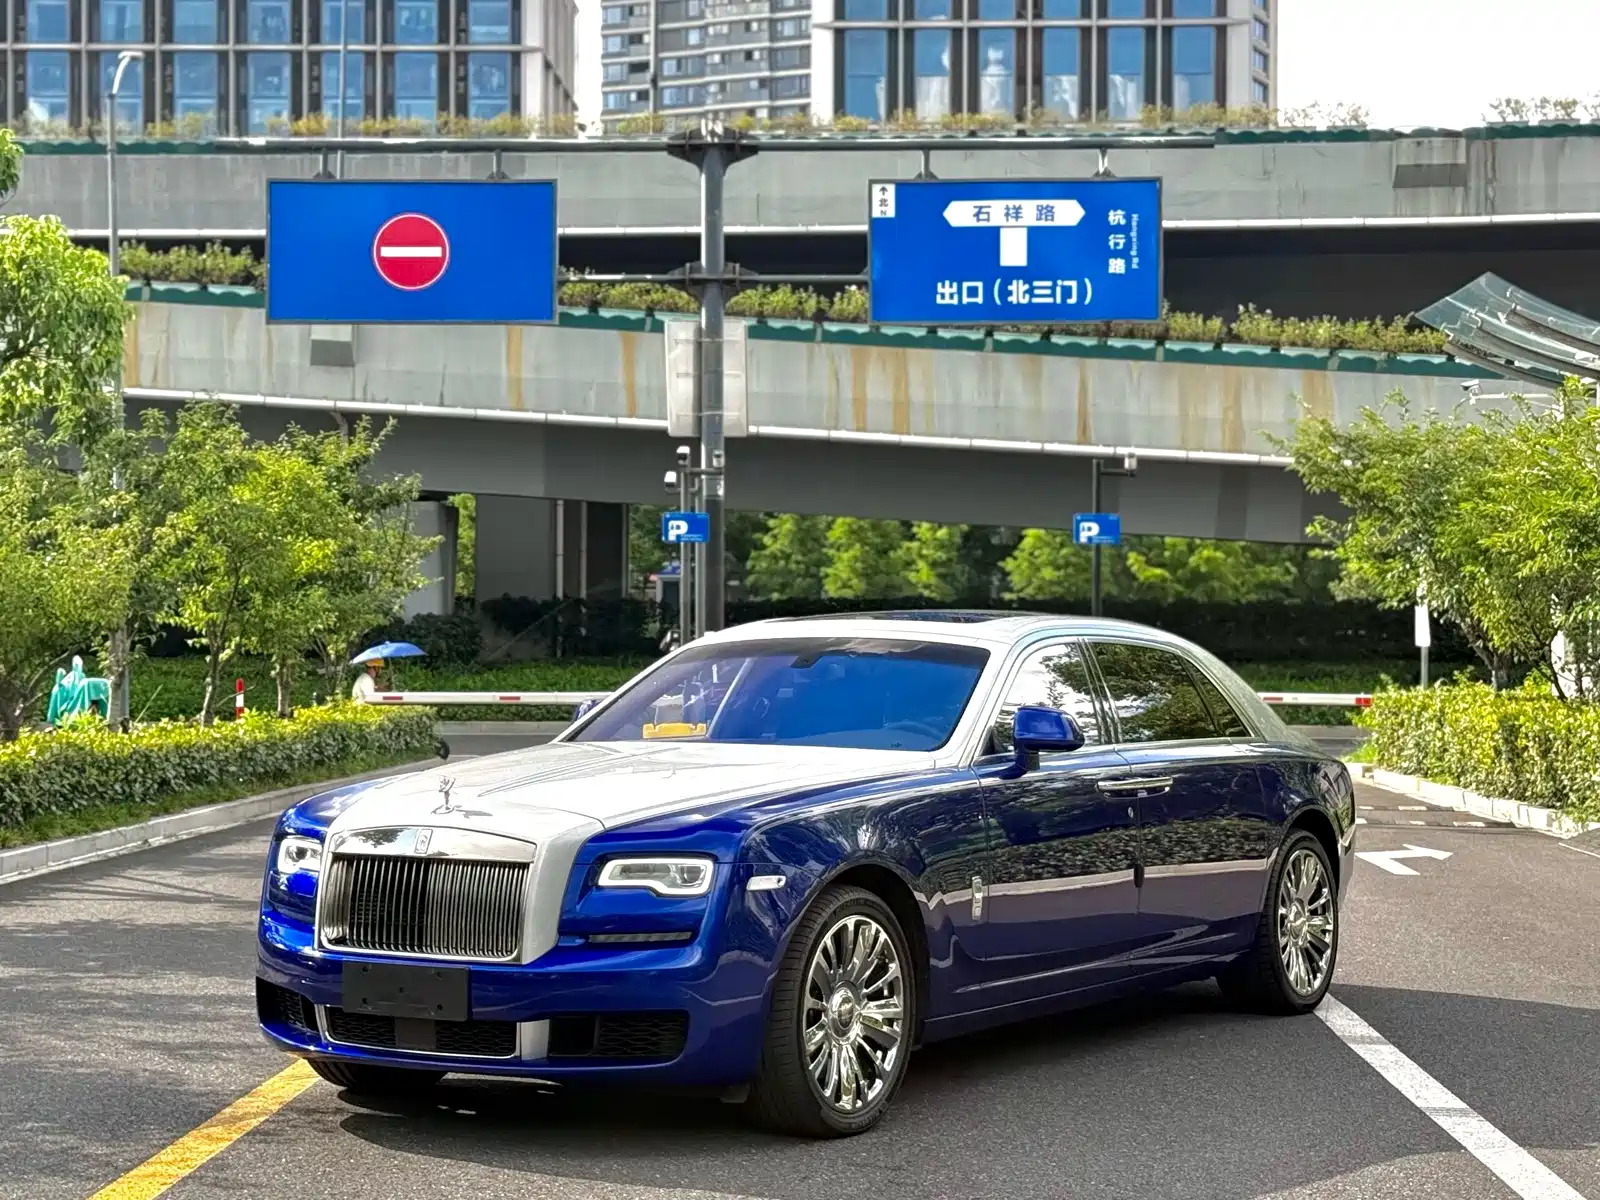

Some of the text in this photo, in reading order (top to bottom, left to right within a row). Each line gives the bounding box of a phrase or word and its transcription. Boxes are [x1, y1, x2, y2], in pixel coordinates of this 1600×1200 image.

[879, 198, 889, 207] 北
[972, 204, 1056, 223] 石祥路
[1108, 209, 1126, 274] 杭行路
[668, 520, 689, 541] P
[1079, 521, 1100, 543] P
